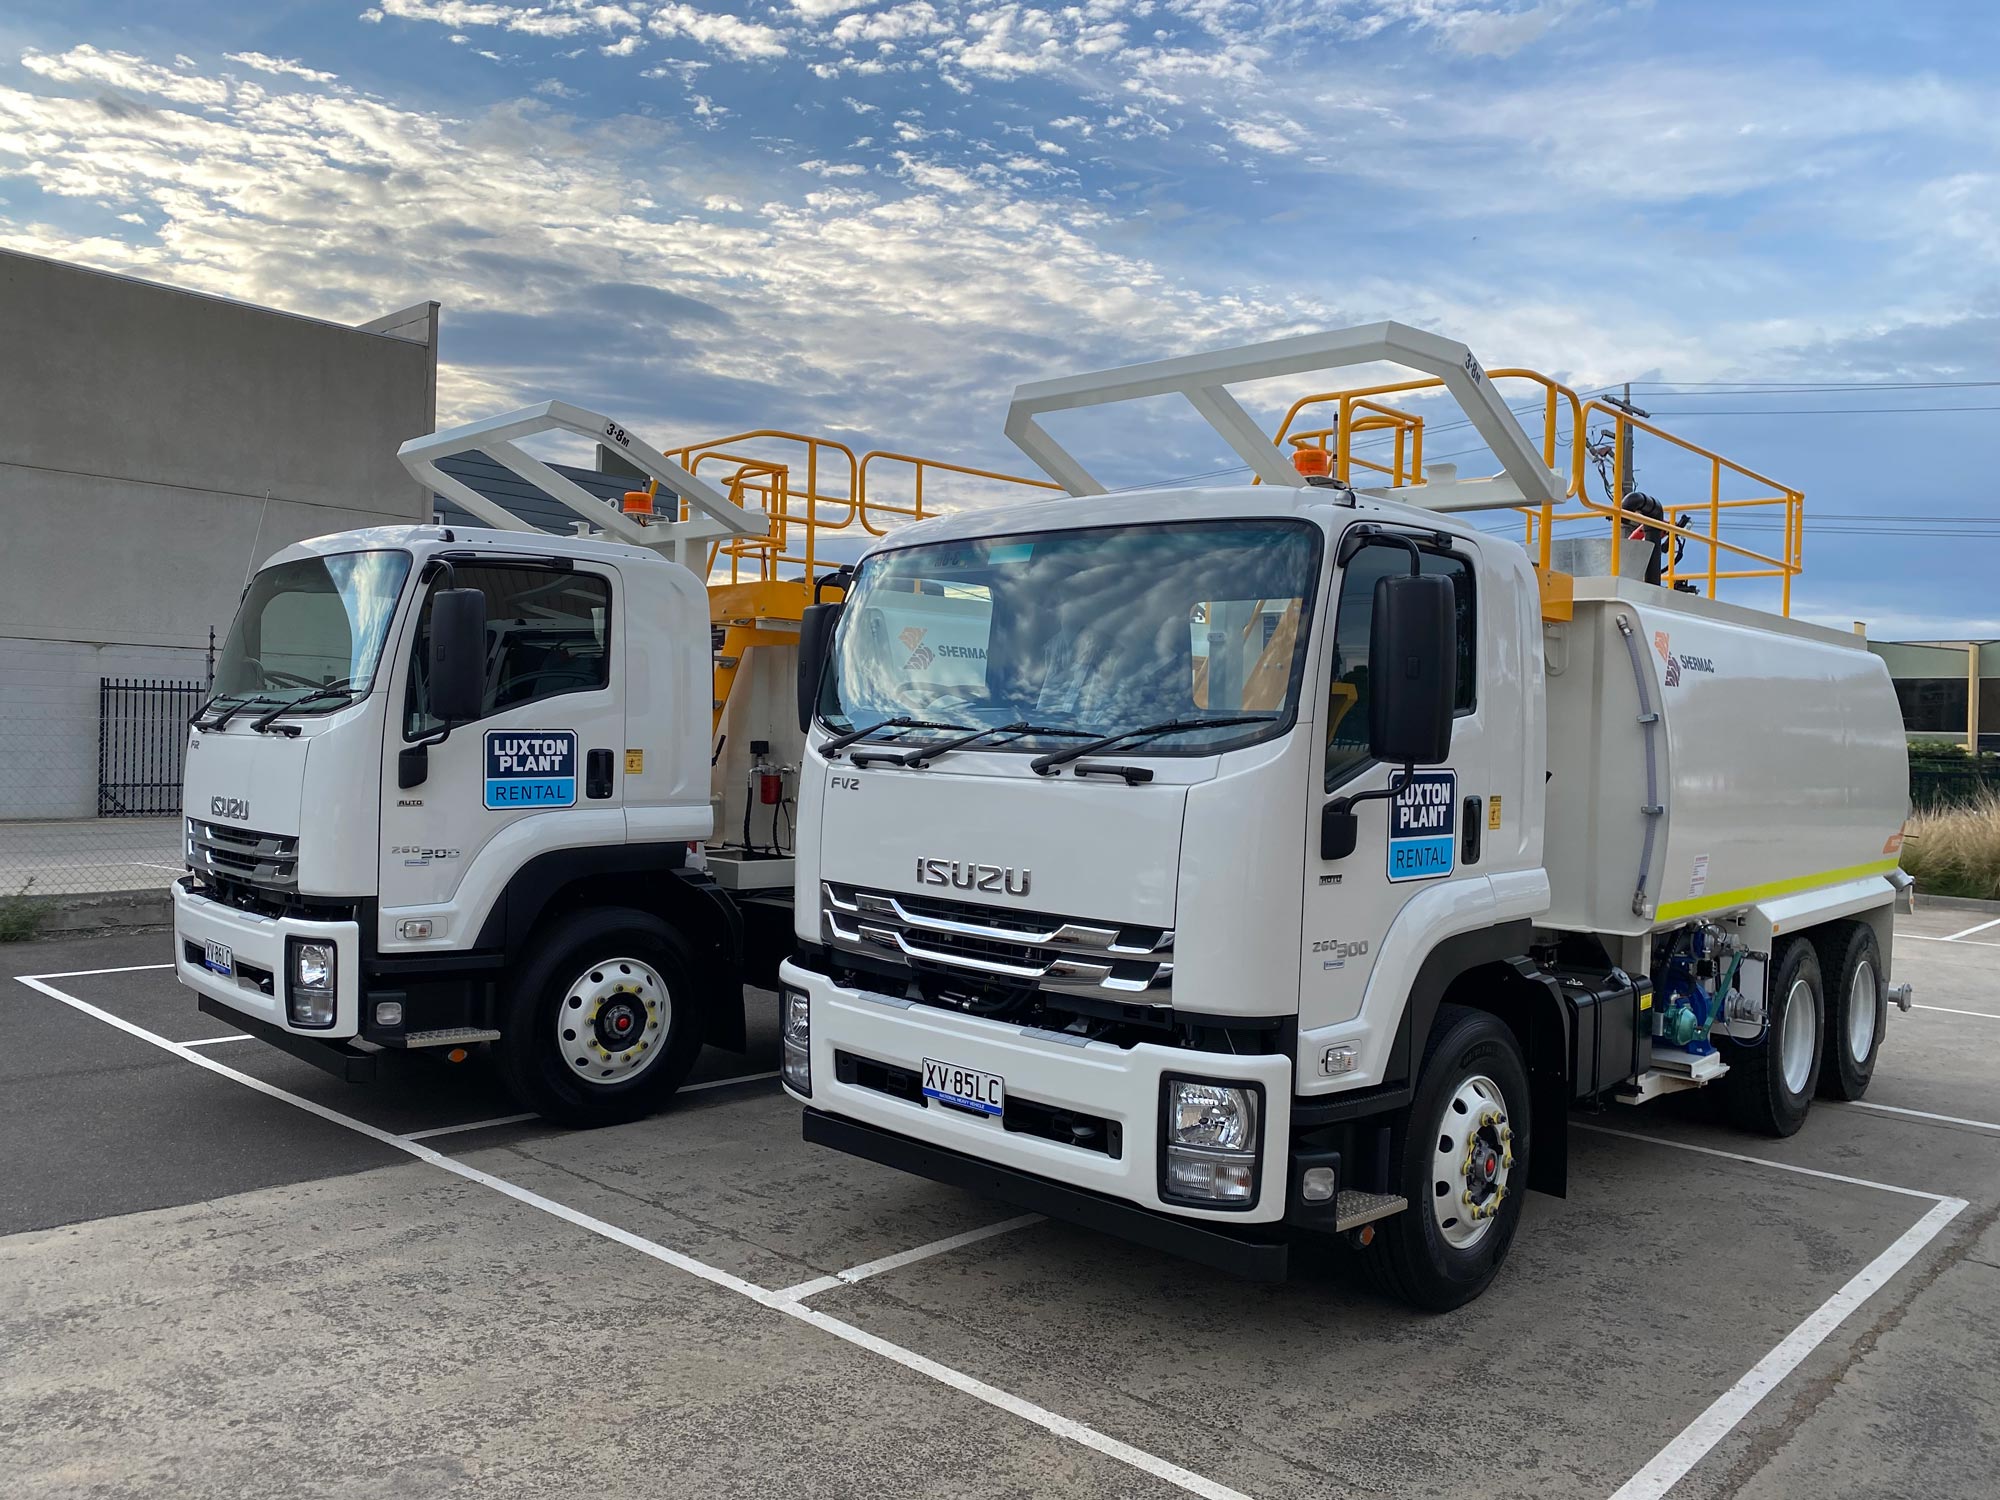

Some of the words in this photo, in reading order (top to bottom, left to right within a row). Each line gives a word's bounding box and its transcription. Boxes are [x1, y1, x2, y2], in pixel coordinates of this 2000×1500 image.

[938, 645, 988, 660] SHERMA
[1680, 654, 1715, 673] SHERMAC
[494, 739, 568, 756] LUXTON
[499, 755, 563, 772] PLANT
[495, 785, 566, 800] RENTAL
[831, 777, 860, 790] FVZ
[1396, 783, 1451, 806] LUXTON
[211, 795, 250, 820] ISUZU
[1400, 805, 1447, 829] PLANT
[392, 846, 420, 854] 260
[1396, 847, 1447, 869] RENTAL
[917, 856, 1032, 897] ISUZU
[1320, 875, 1342, 884] AUTO
[1312, 940, 1338, 953] 260
[1337, 941, 1368, 959] 300
